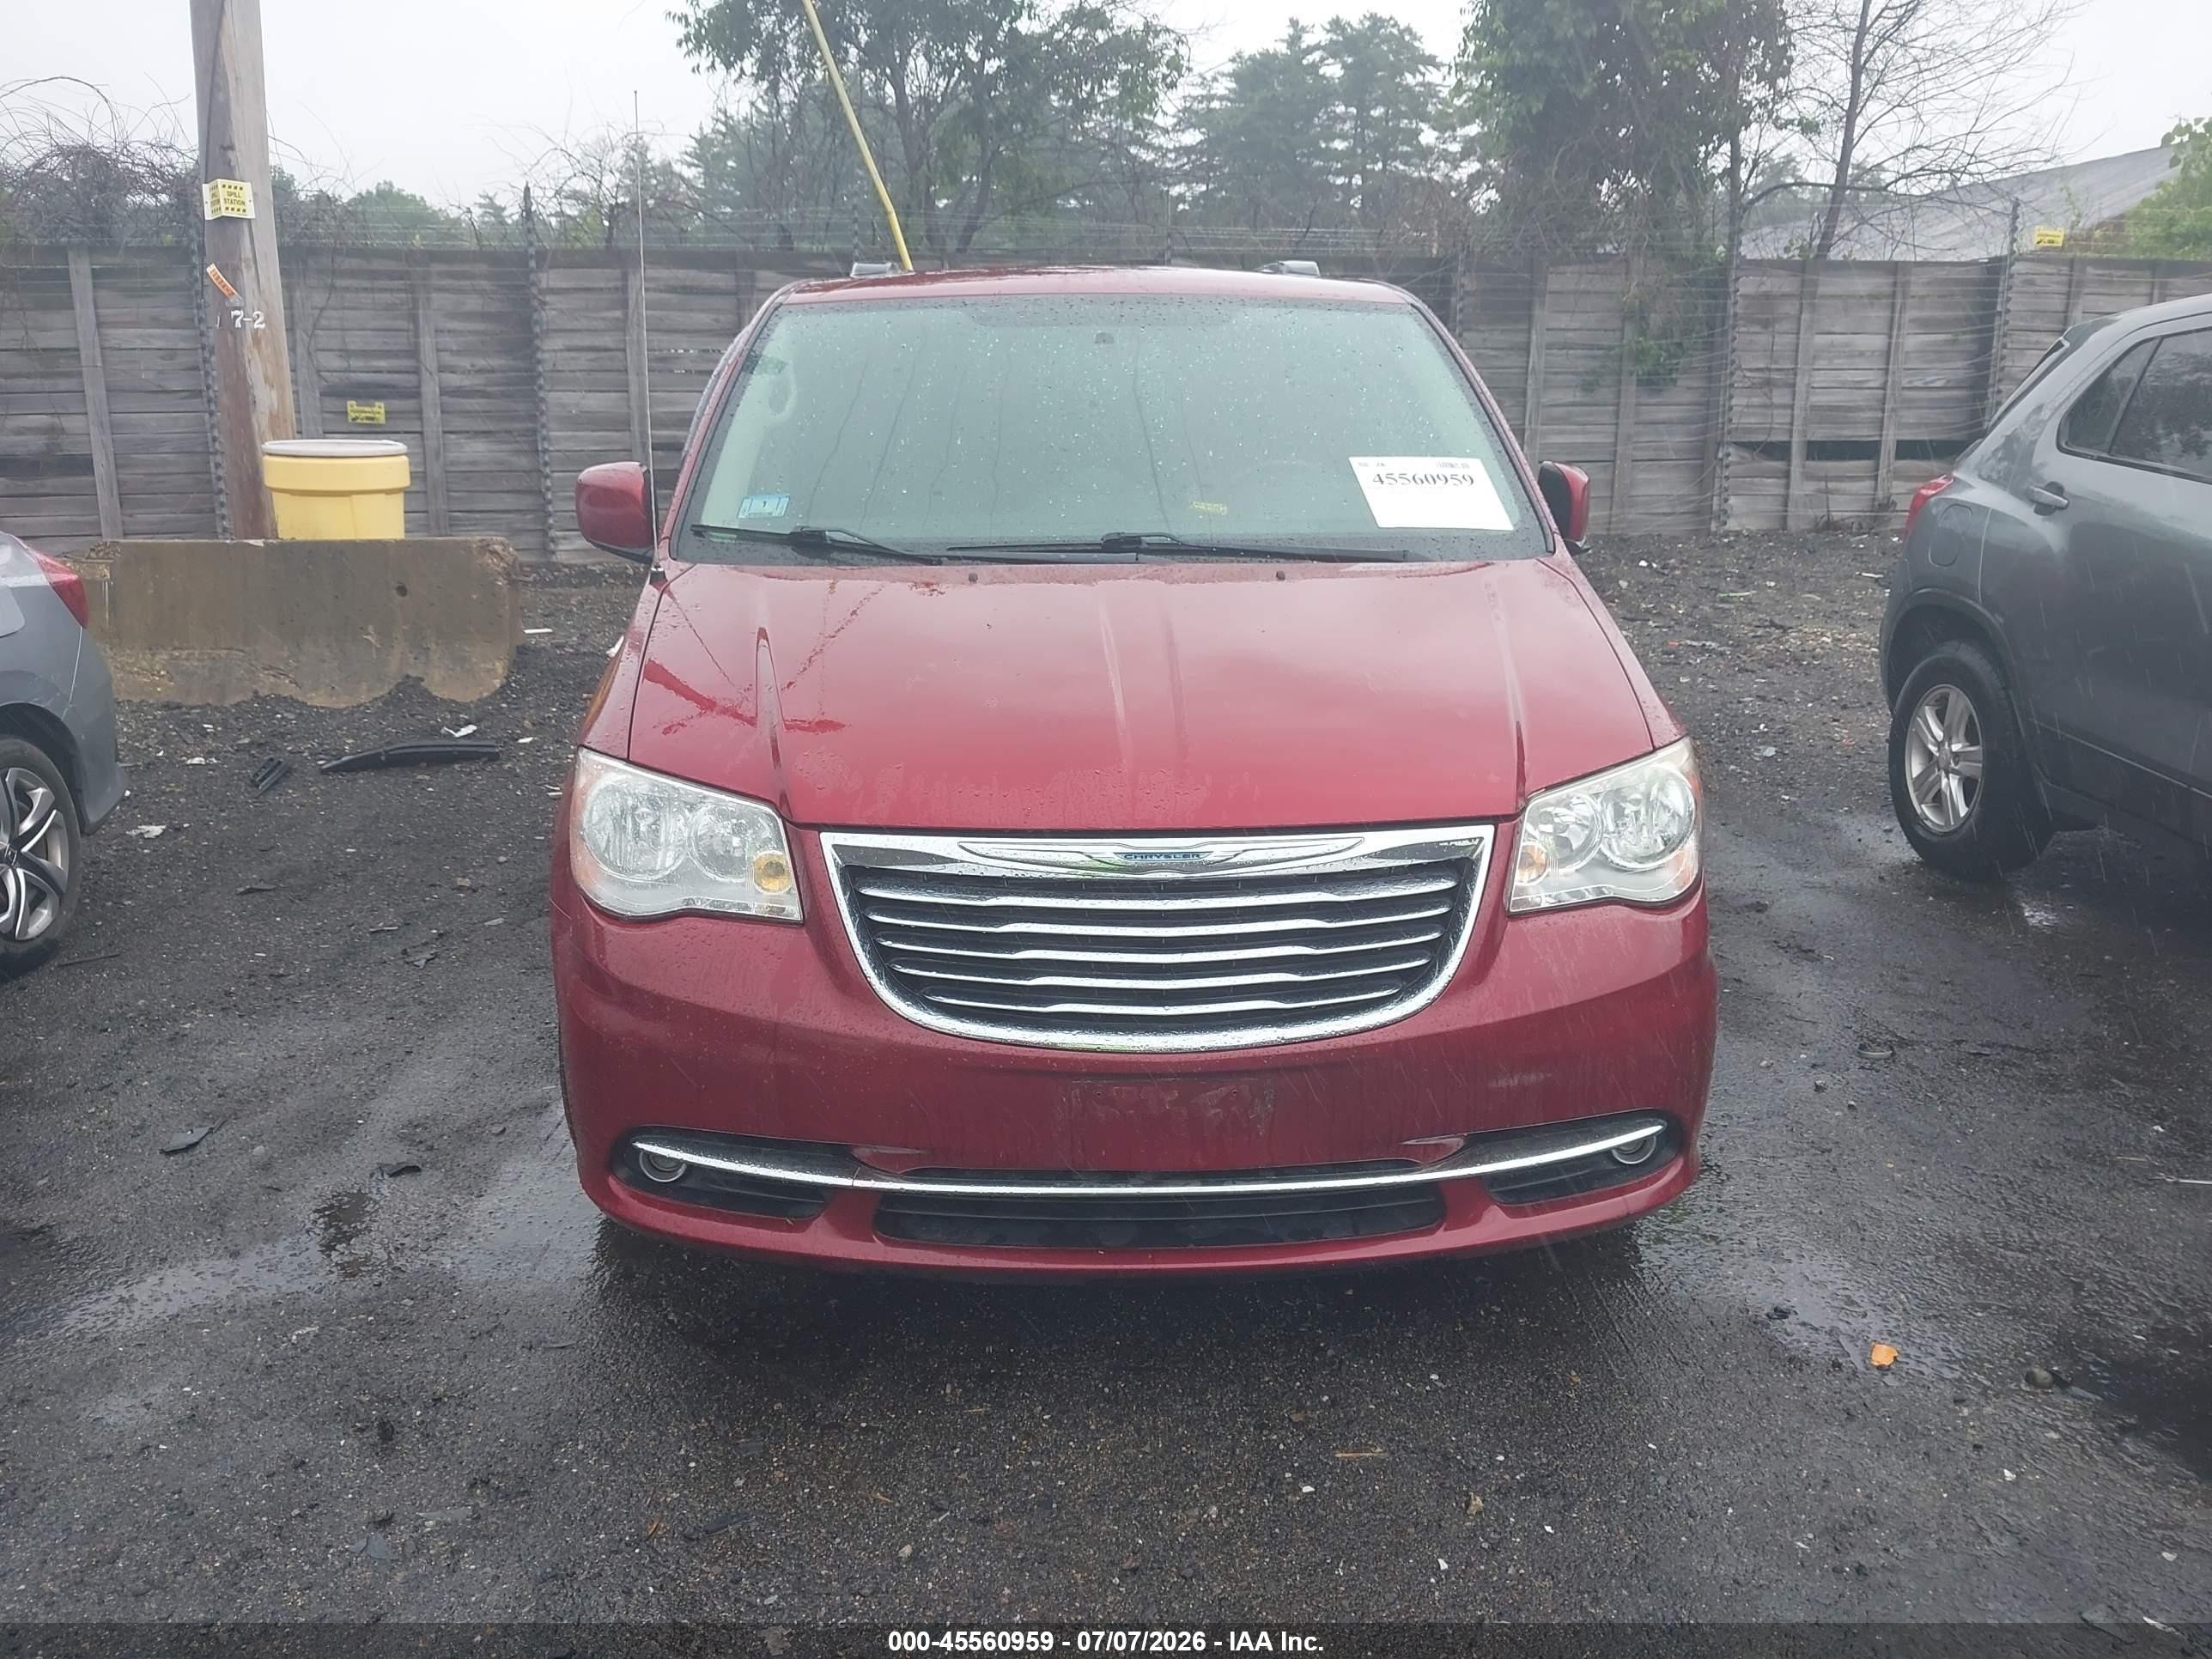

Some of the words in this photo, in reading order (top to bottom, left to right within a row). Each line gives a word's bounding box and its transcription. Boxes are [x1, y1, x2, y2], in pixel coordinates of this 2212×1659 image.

[223, 198, 246, 206] STATION
[230, 309, 266, 329] 7-2
[1372, 472, 1475, 487] 45560959
